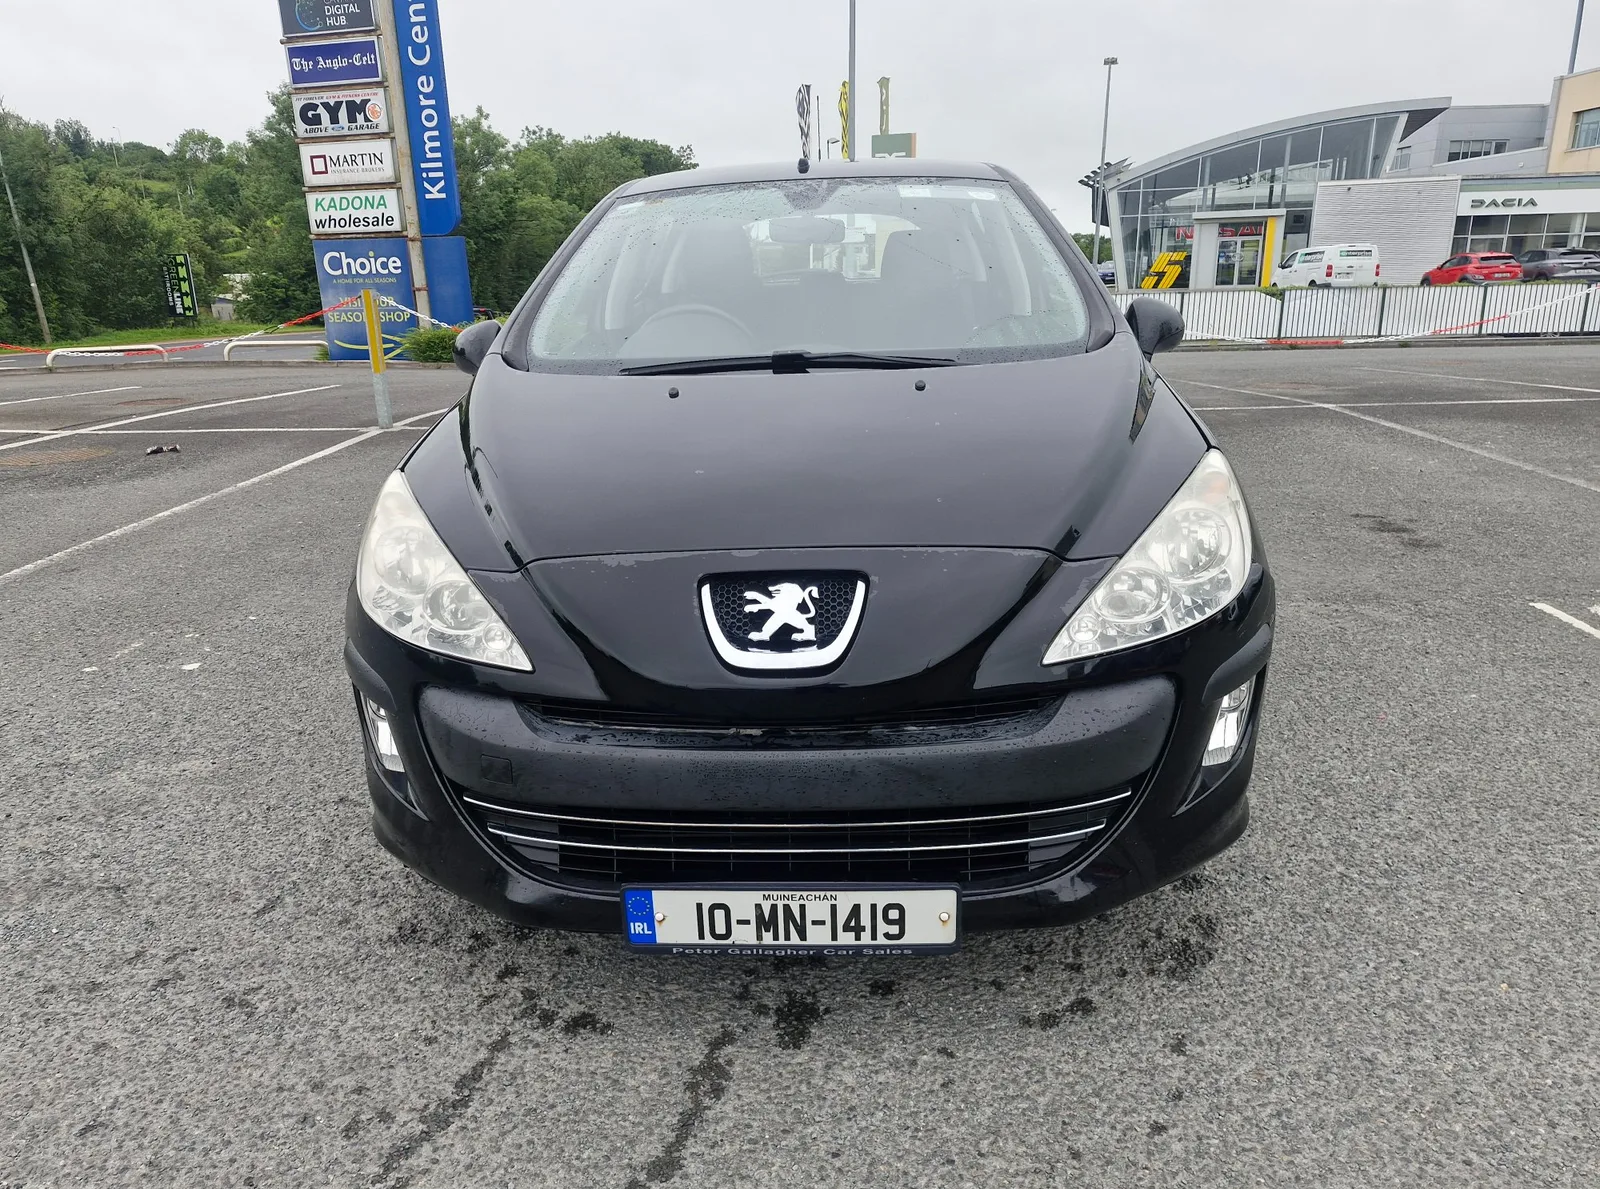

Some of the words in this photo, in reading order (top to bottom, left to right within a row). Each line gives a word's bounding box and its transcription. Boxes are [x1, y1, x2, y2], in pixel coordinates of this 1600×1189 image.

[325, 3, 360, 15] DIGITAL
[326, 16, 348, 27] HUB
[408, 0, 431, 66] Cen
[291, 58, 315, 73] The
[315, 52, 376, 71] Anglo-Celt
[299, 99, 374, 126] GYM
[302, 126, 330, 135] ABOVE
[347, 122, 381, 132] GARAGE
[417, 75, 447, 200] Kilmore
[328, 151, 384, 168] MARTIN
[314, 194, 388, 213] KADONA
[1471, 197, 1538, 208] DACIA
[314, 212, 395, 230] wholesale
[322, 250, 402, 276] Choice
[327, 311, 366, 323] SEASO
[380, 311, 411, 322] SHOP
[630, 921, 652, 935] IRL
[695, 902, 906, 942] 10-MN-1419
[672, 947, 721, 955] Peter
[727, 948, 817, 956] Gallagher
